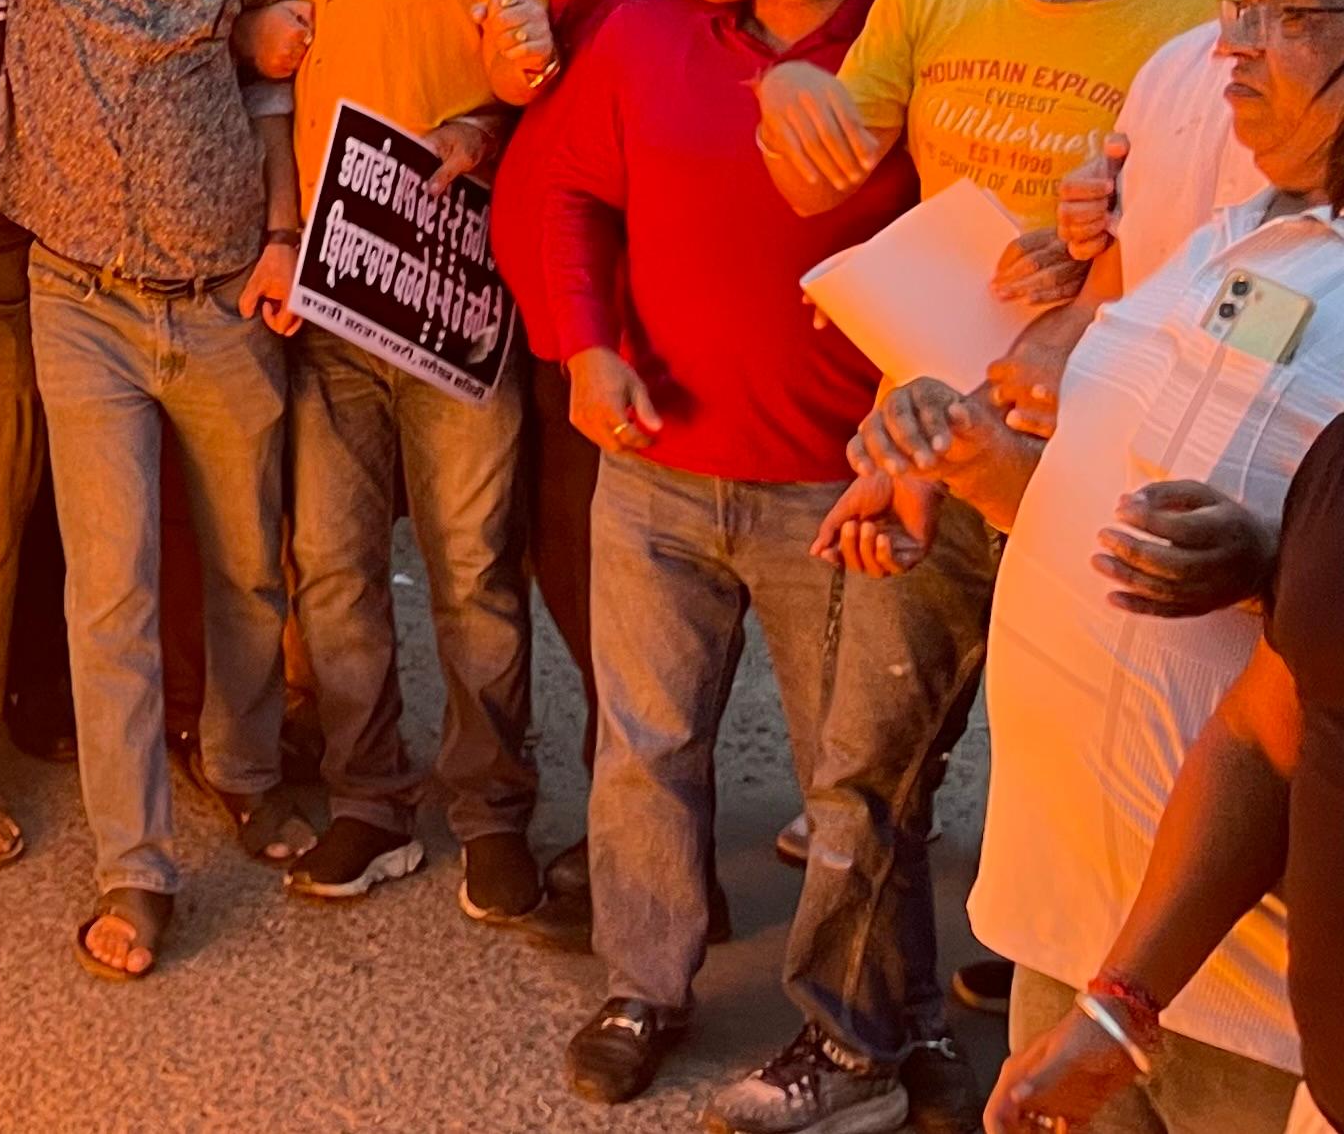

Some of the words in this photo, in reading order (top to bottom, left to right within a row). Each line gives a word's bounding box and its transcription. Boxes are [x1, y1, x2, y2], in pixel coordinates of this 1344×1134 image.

[920, 59, 1028, 88] MOUNTAIN
[1032, 65, 1126, 116] EXPLOR
[985, 86, 1061, 115] EVEREST
[926, 97, 1102, 163] Wildernes
[1013, 178, 1062, 197] ADVE
